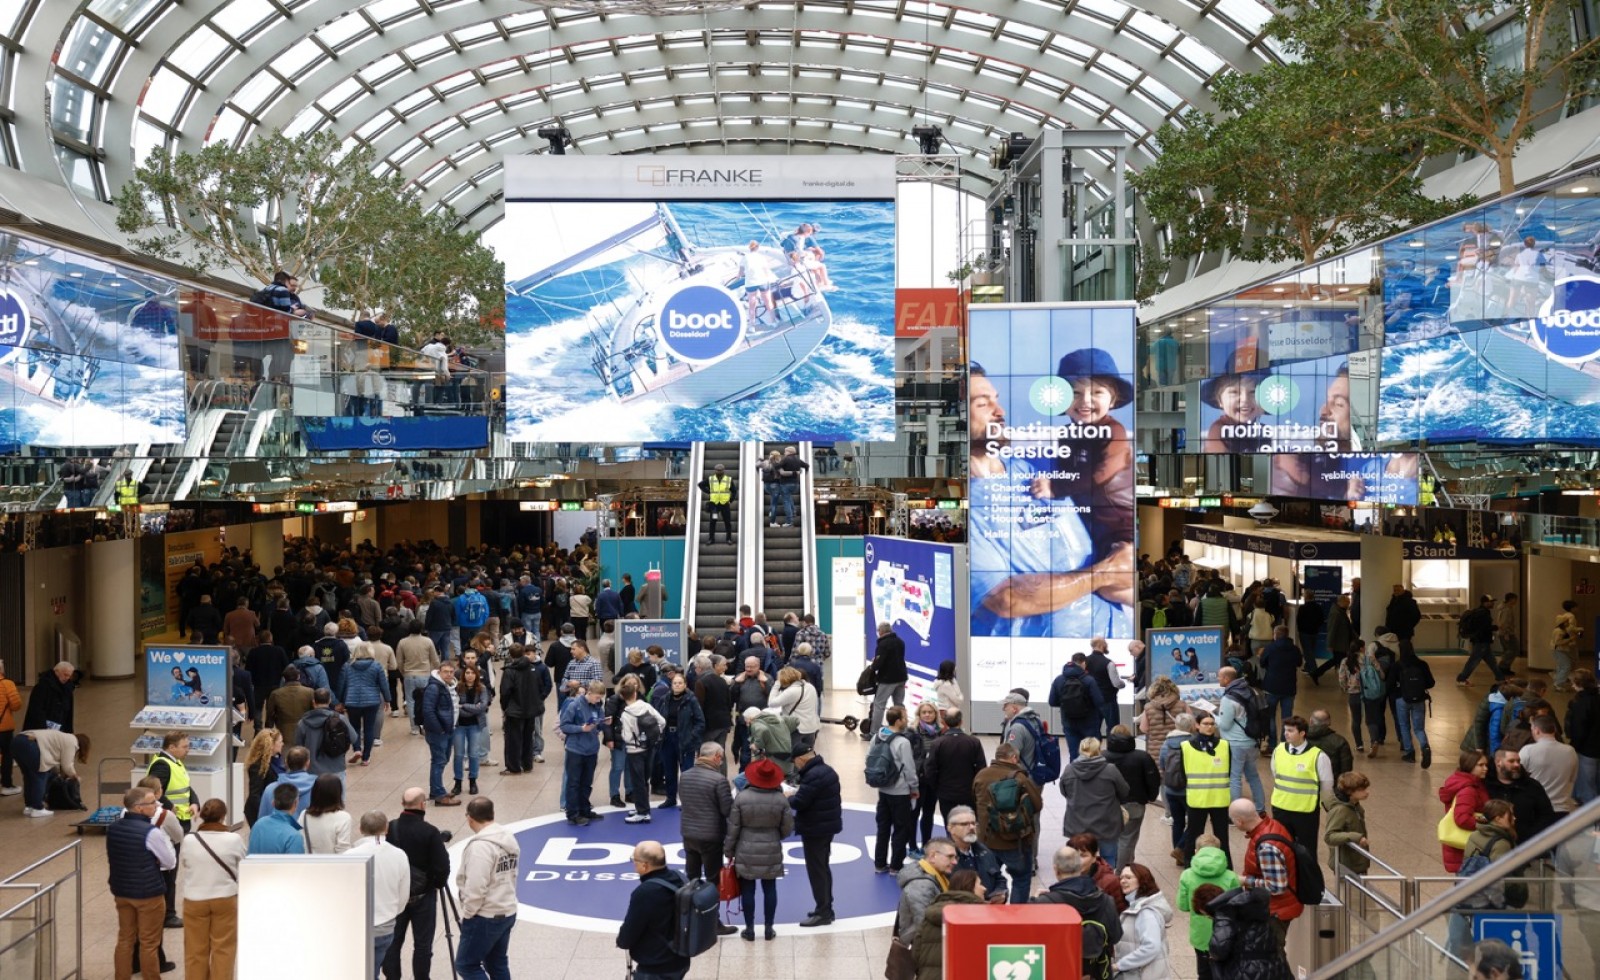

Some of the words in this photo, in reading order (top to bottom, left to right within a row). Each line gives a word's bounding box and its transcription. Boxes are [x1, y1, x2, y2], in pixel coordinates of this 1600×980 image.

[666, 169, 762, 183] FRANKE
[802, 180, 855, 189] franke-digital.de
[669, 308, 733, 330] boot
[896, 302, 957, 330] FAI
[669, 329, 711, 339] Düsseldorf
[986, 421, 1112, 439] Destination
[986, 441, 1071, 459] Seaside
[984, 470, 1009, 480] Book
[1013, 471, 1036, 482] your
[1038, 470, 1080, 482] Holiday:
[991, 483, 1031, 492] Charter
[991, 494, 1032, 503] Marinas
[1413, 545, 1457, 558] Stand
[625, 624, 649, 633] boot
[641, 631, 678, 640] generation
[1152, 634, 1173, 646] We
[1186, 633, 1219, 645] water
[150, 651, 171, 663] We
[188, 653, 225, 665] water
